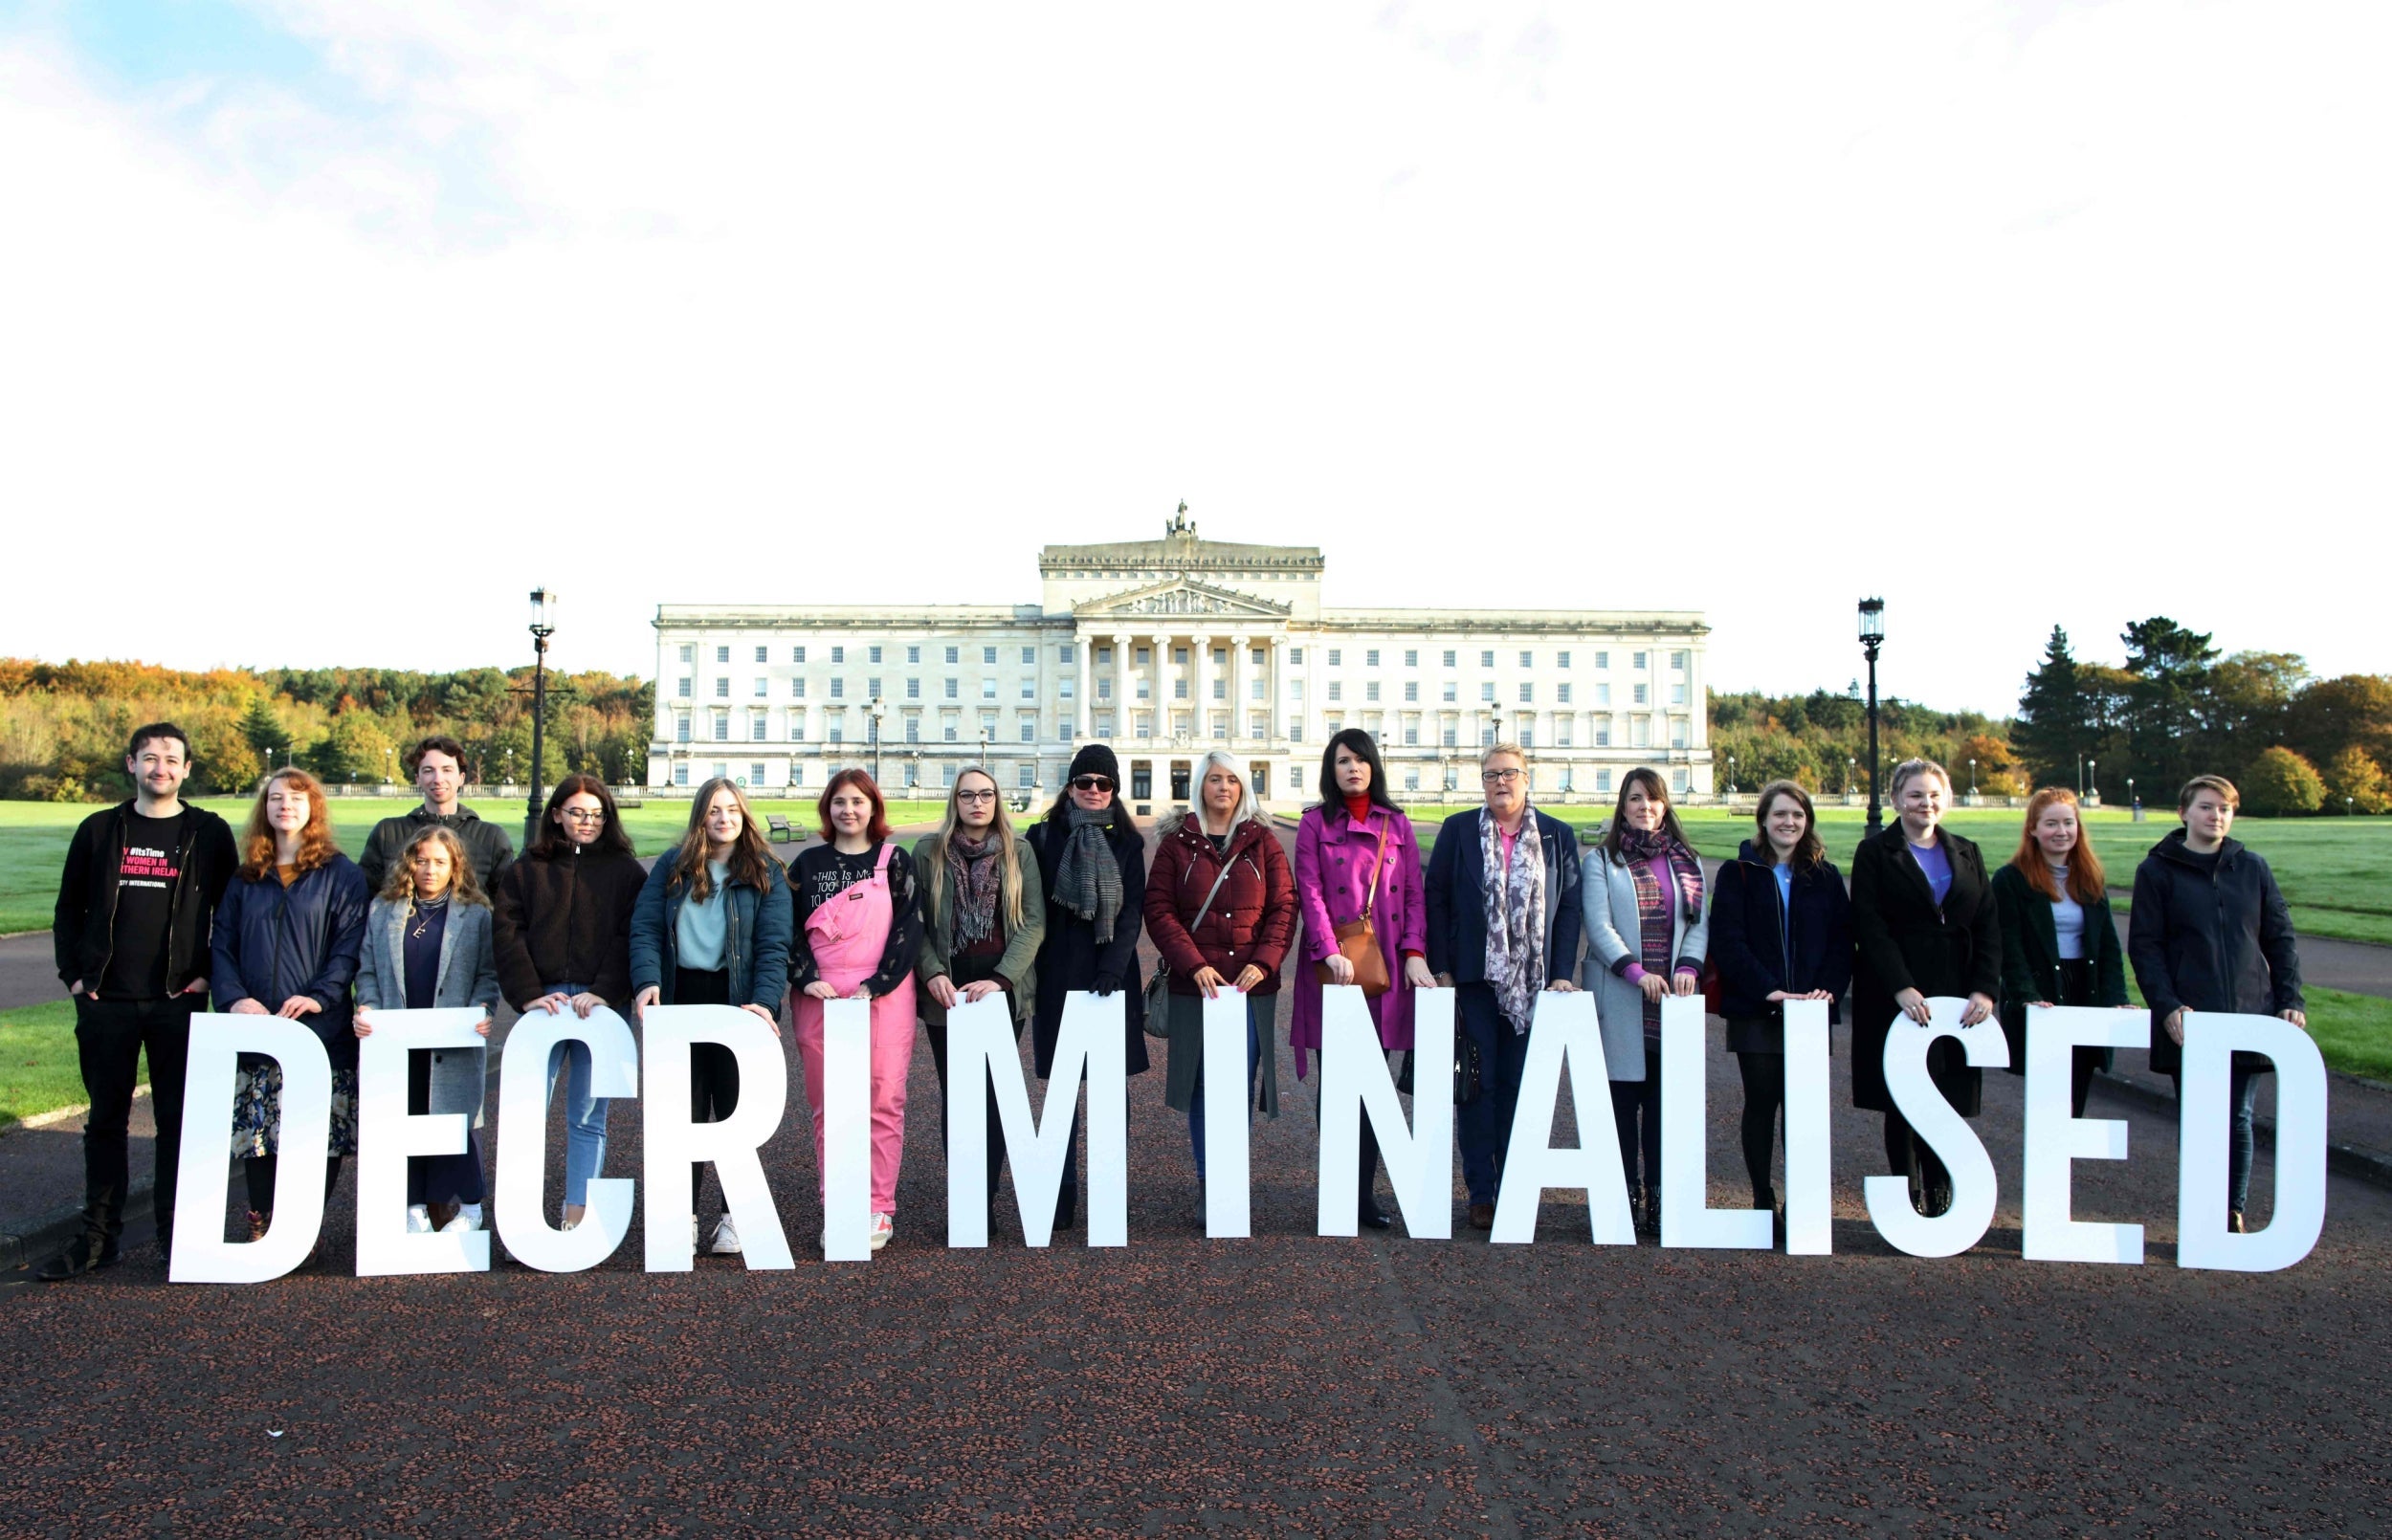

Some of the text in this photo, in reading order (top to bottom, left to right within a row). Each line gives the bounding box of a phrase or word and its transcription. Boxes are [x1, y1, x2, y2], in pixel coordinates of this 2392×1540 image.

[130, 847, 165, 858] #ItsTime
[126, 856, 168, 867] WOMEN IN
[817, 871, 837, 882] THIS
[129, 880, 166, 889] INTERNATIONAL
[817, 881, 836, 892] TOO
[168, 984, 2328, 1285] DECRIMINALISED
